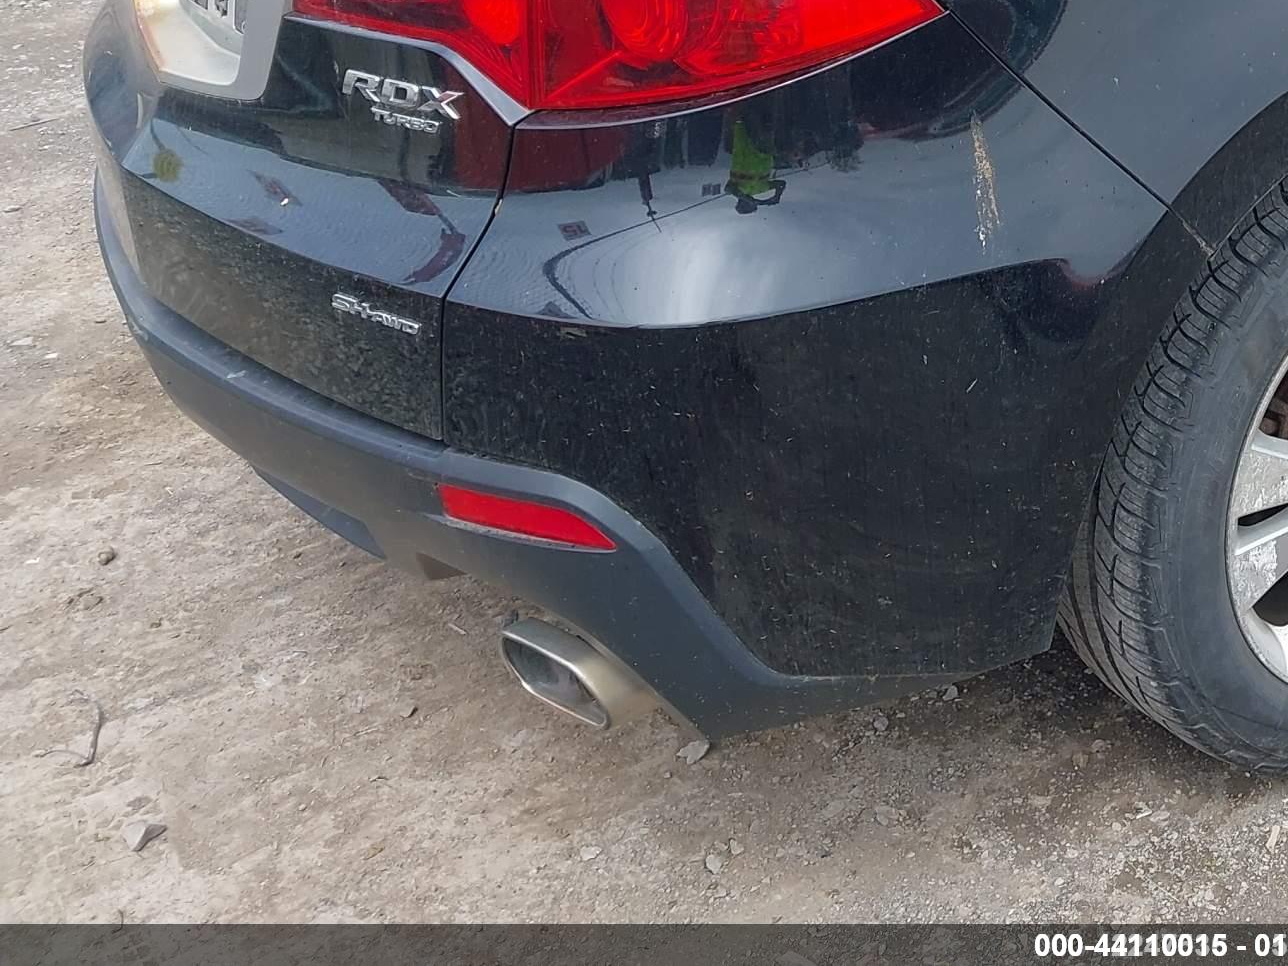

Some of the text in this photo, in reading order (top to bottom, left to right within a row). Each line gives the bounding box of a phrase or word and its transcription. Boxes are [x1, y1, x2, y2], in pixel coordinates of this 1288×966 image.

[342, 68, 464, 120] RDX
[370, 105, 443, 134] TURBO
[331, 292, 422, 335] SH-AWD
